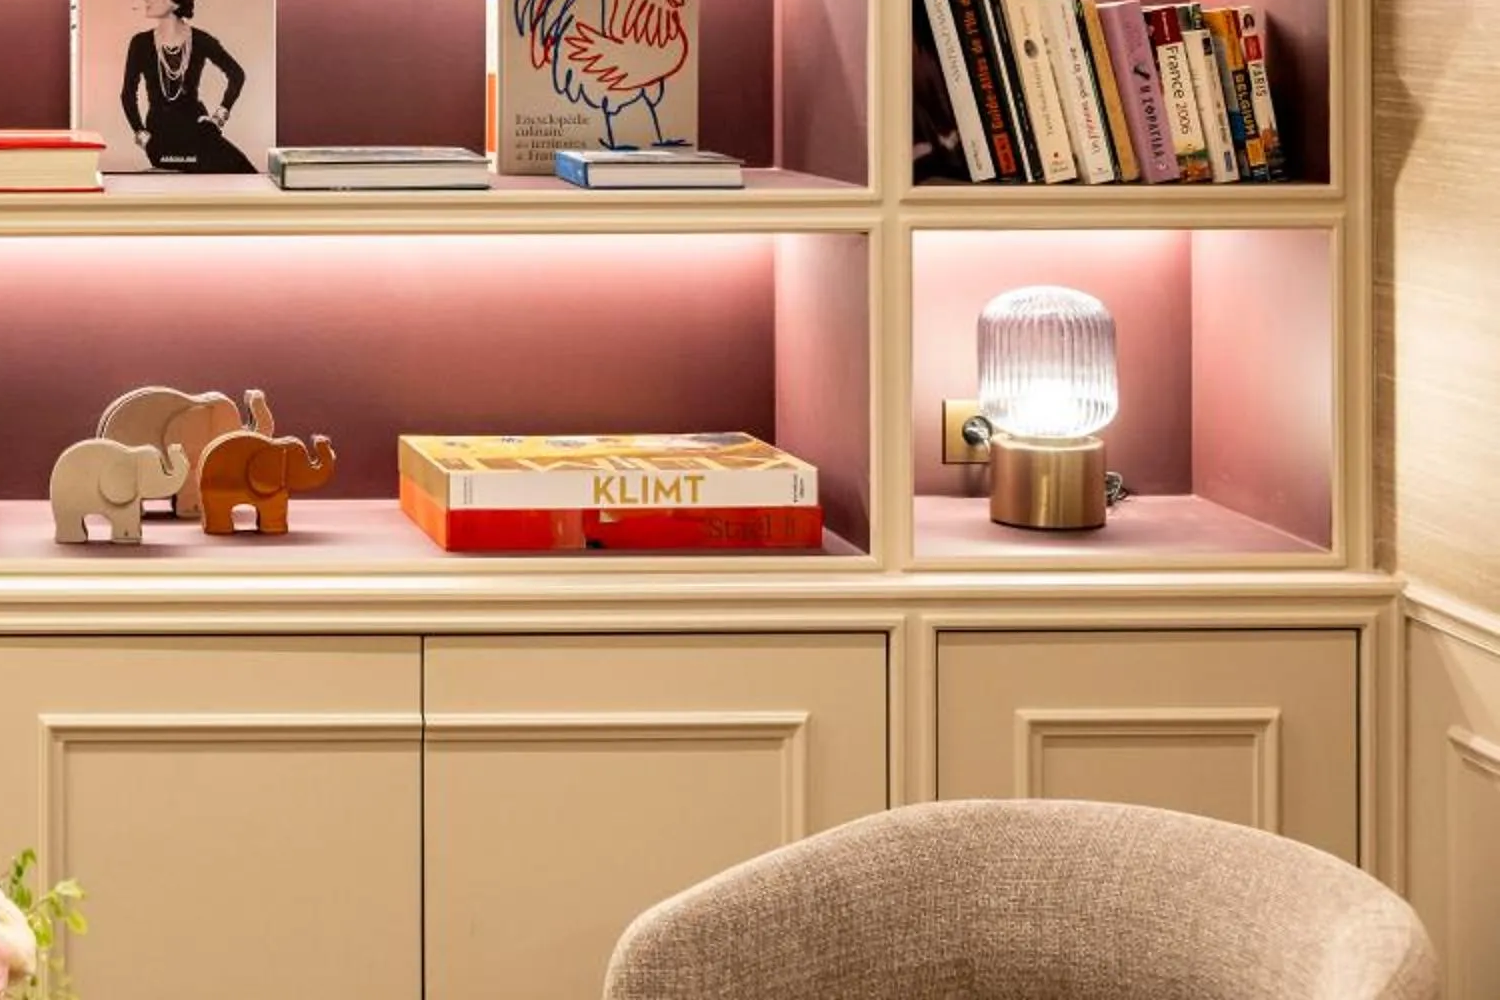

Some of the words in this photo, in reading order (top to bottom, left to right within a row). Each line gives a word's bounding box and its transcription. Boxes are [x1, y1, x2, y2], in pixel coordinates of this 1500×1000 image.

[1166, 45, 1188, 98] France
[1251, 63, 1267, 96] PARIS
[1236, 74, 1256, 136] BELGIUM
[593, 475, 706, 505] KLIMT
